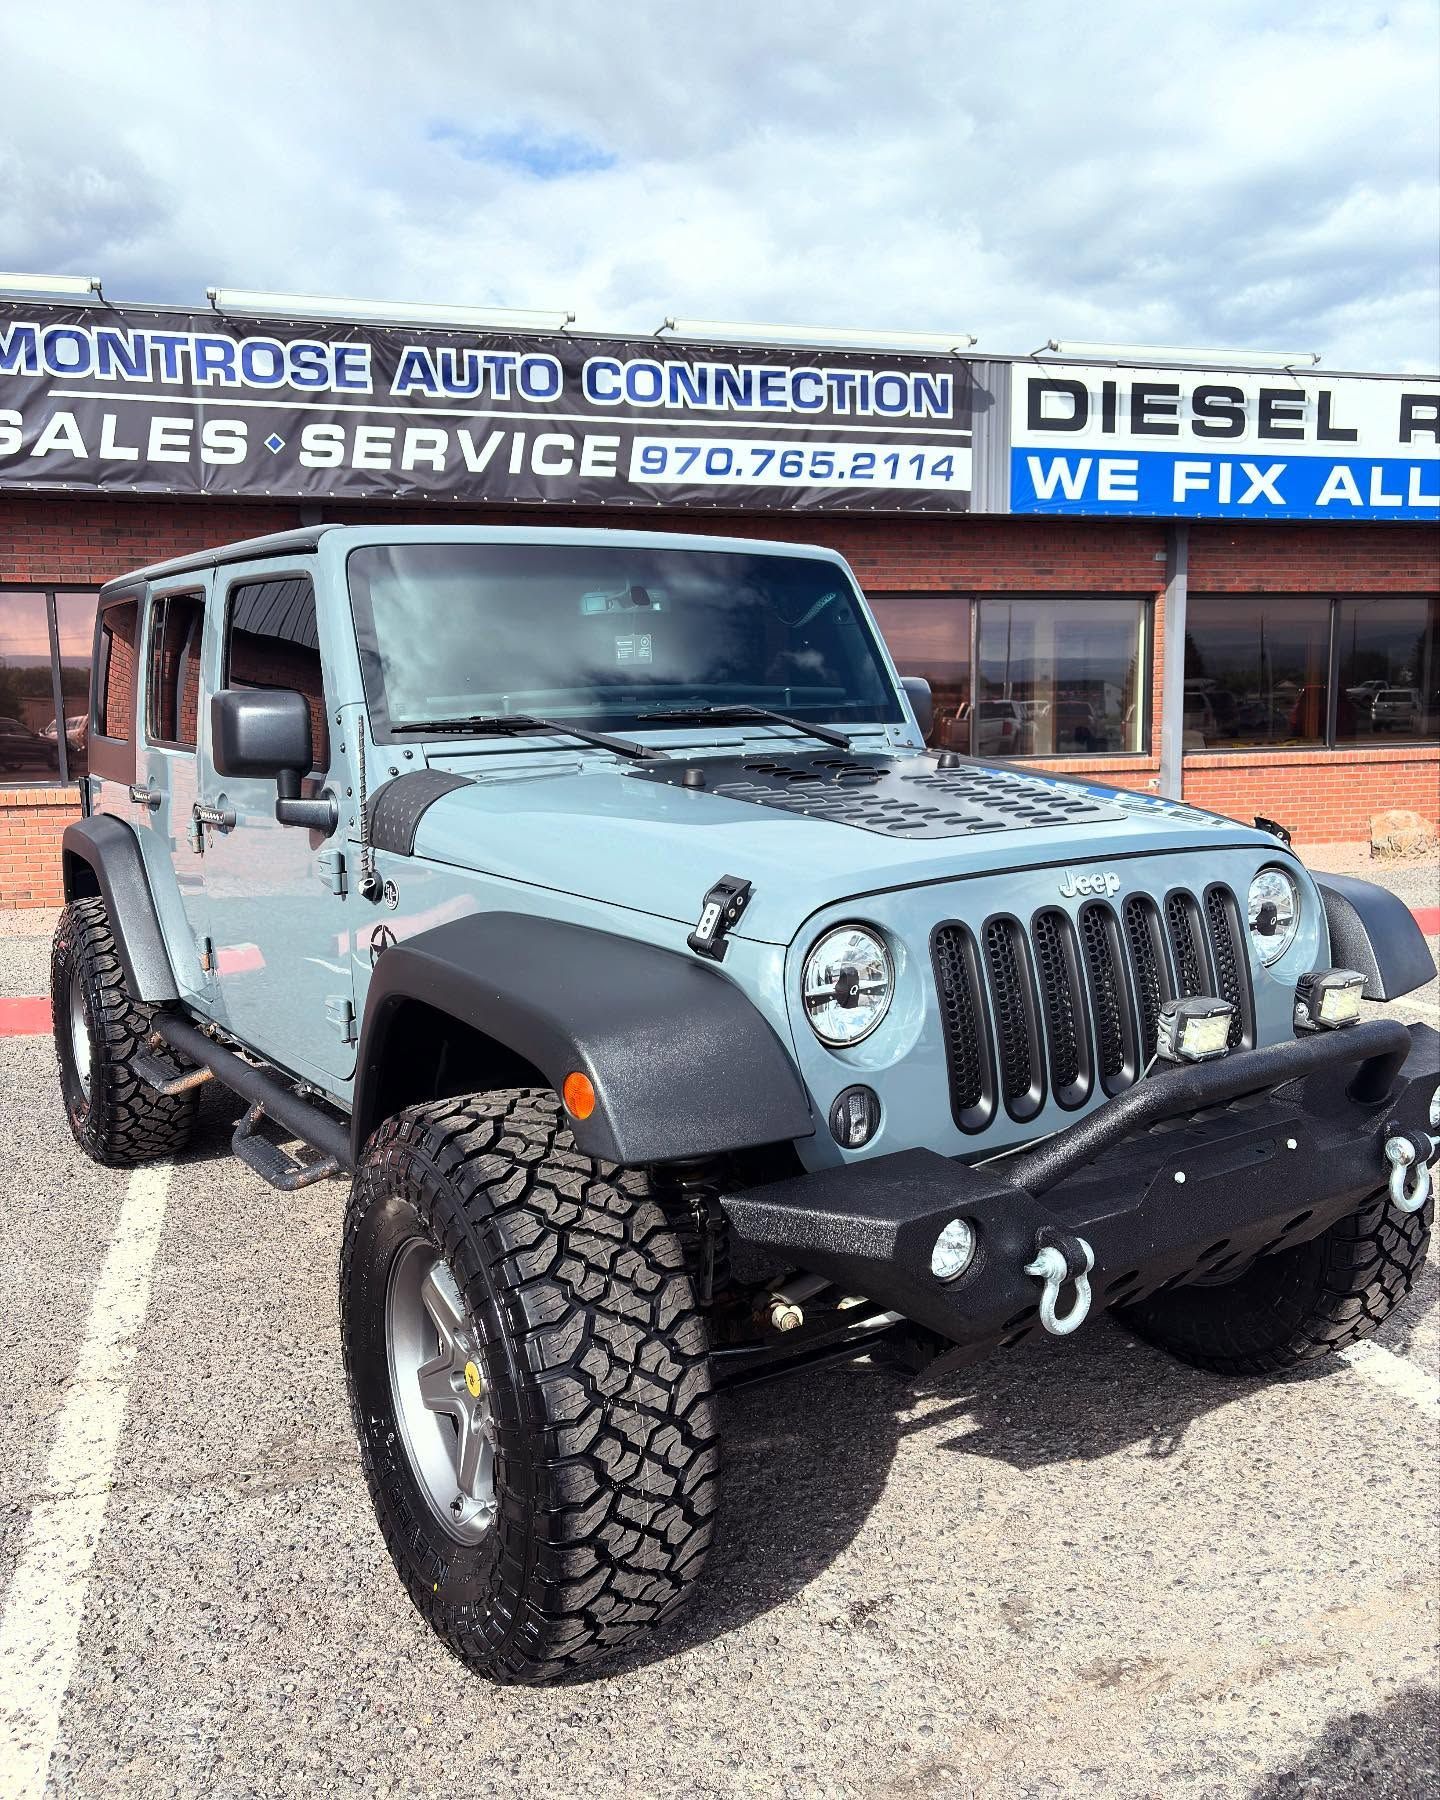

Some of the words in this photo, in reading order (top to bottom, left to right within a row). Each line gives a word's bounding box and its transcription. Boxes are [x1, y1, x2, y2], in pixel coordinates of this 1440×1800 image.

[0, 321, 373, 395] MONTROSE
[391, 345, 563, 403] AUTO
[582, 356, 954, 419] CONNECTION
[1027, 378, 1358, 442] DIESEL
[300, 424, 621, 477] SERVICE
[640, 445, 955, 482] 970.765.2114
[1027, 456, 1139, 502] WE
[1173, 461, 1287, 505] FIX
[1315, 465, 1440, 507] ALL
[1058, 869, 1120, 898] Jeep
